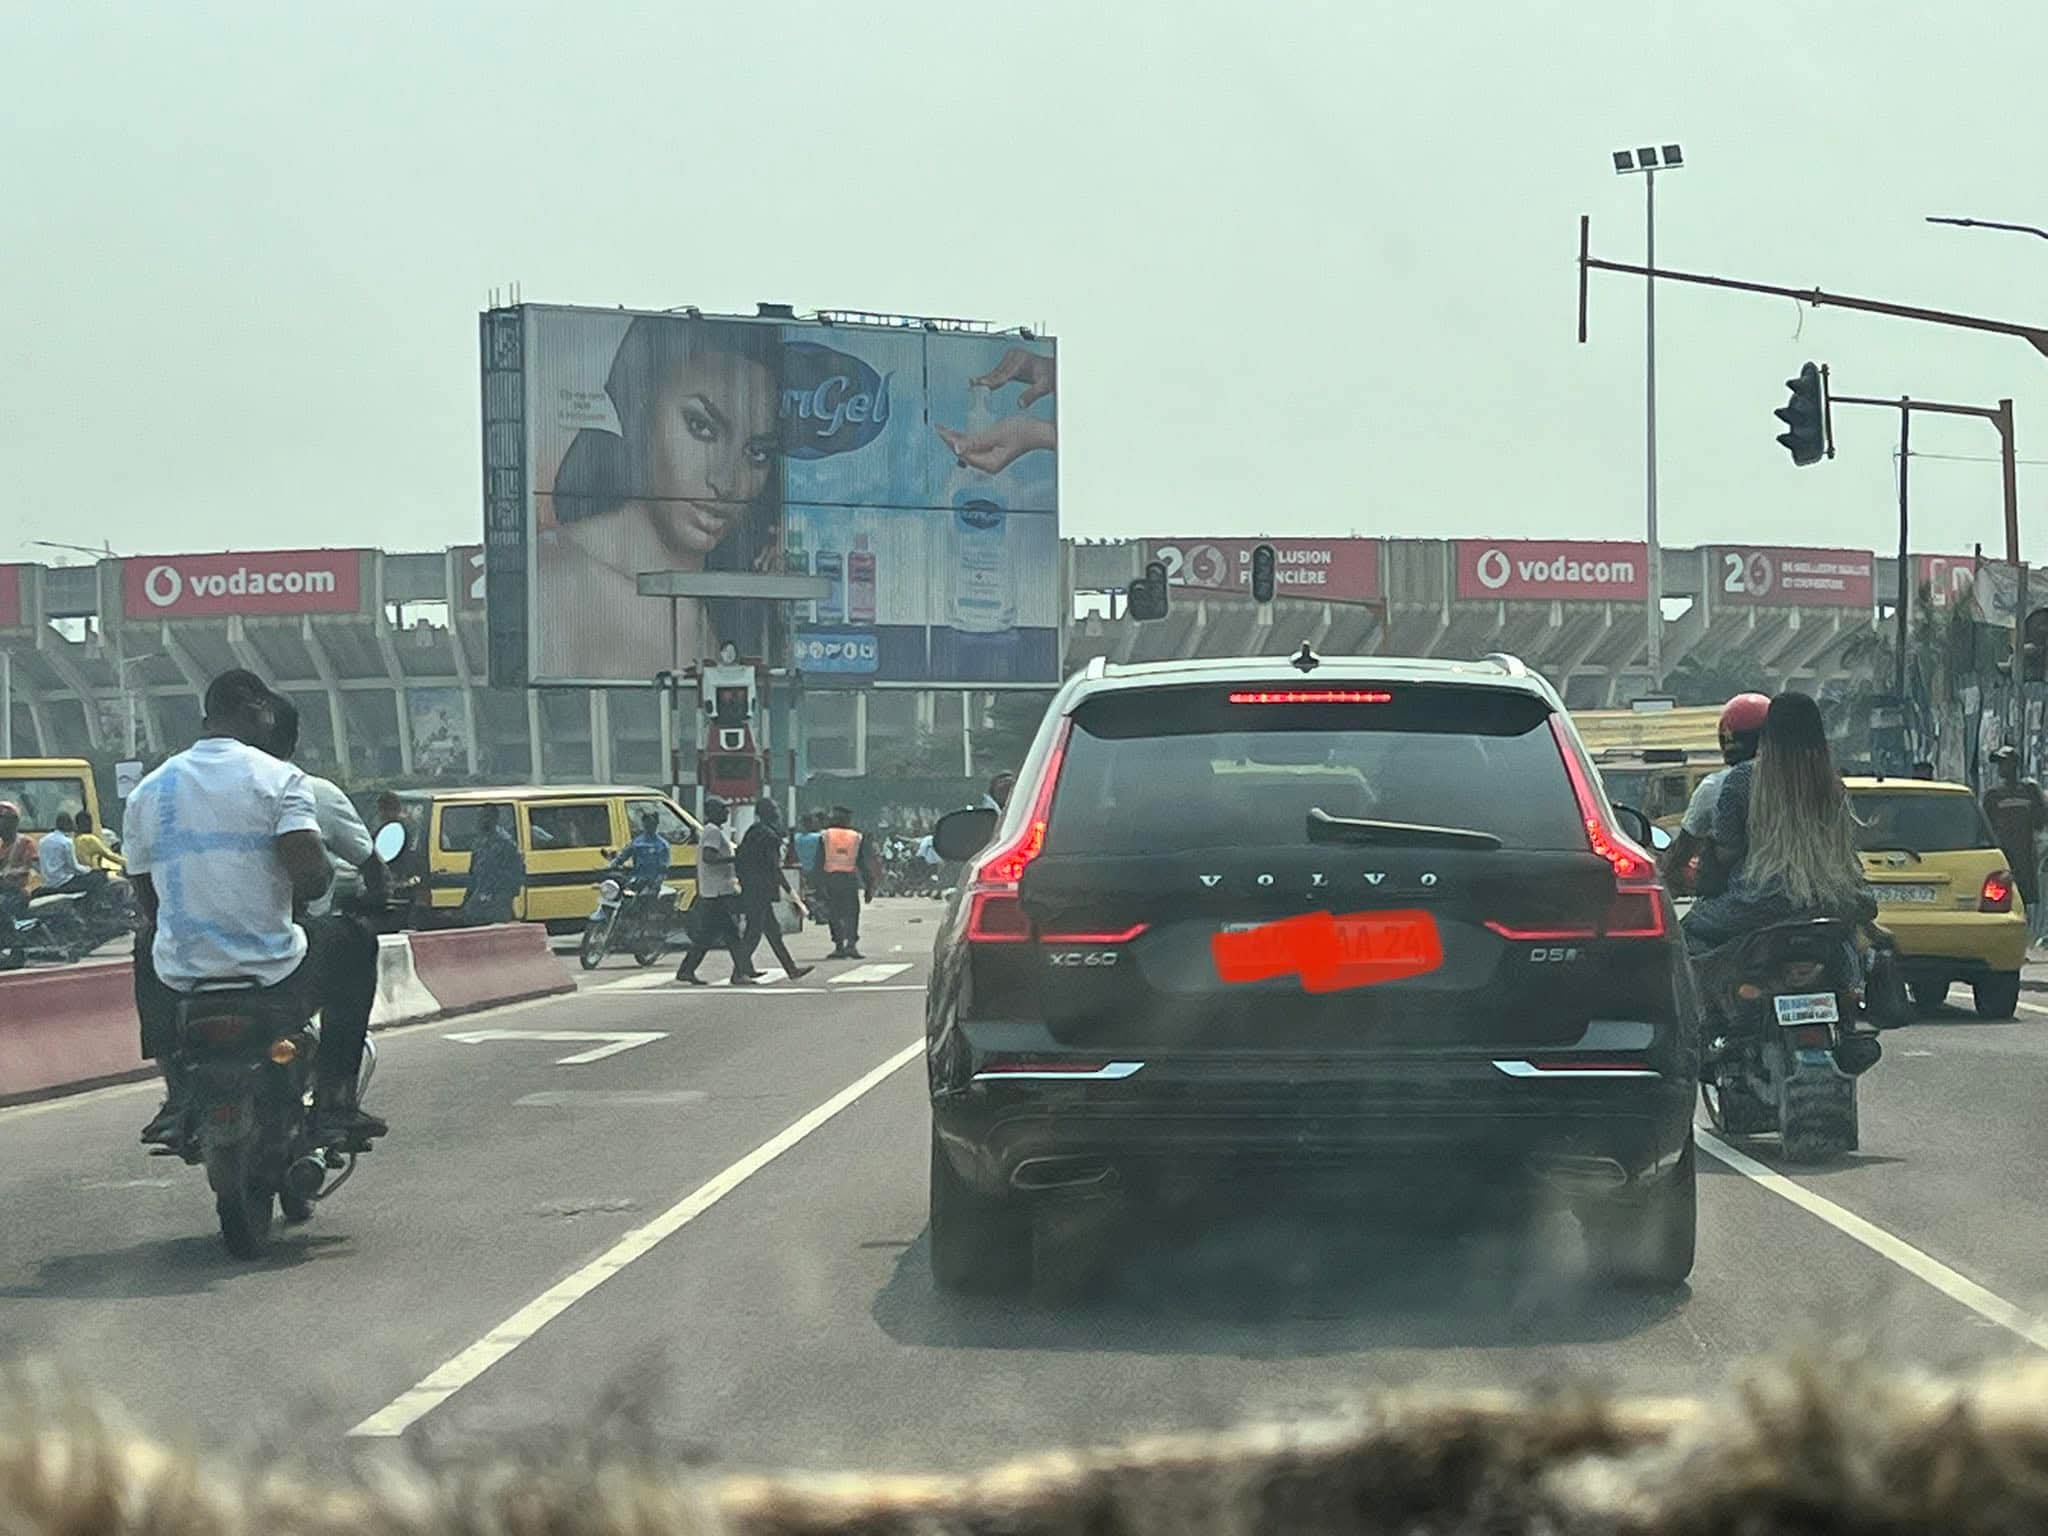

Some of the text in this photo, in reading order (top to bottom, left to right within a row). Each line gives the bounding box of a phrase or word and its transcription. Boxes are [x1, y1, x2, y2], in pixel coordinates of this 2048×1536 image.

[1517, 555, 1634, 583] vodacom
[189, 567, 335, 597] vodacom
[1199, 872, 1438, 888] VOLVO
[1049, 951, 1118, 966] XC60
